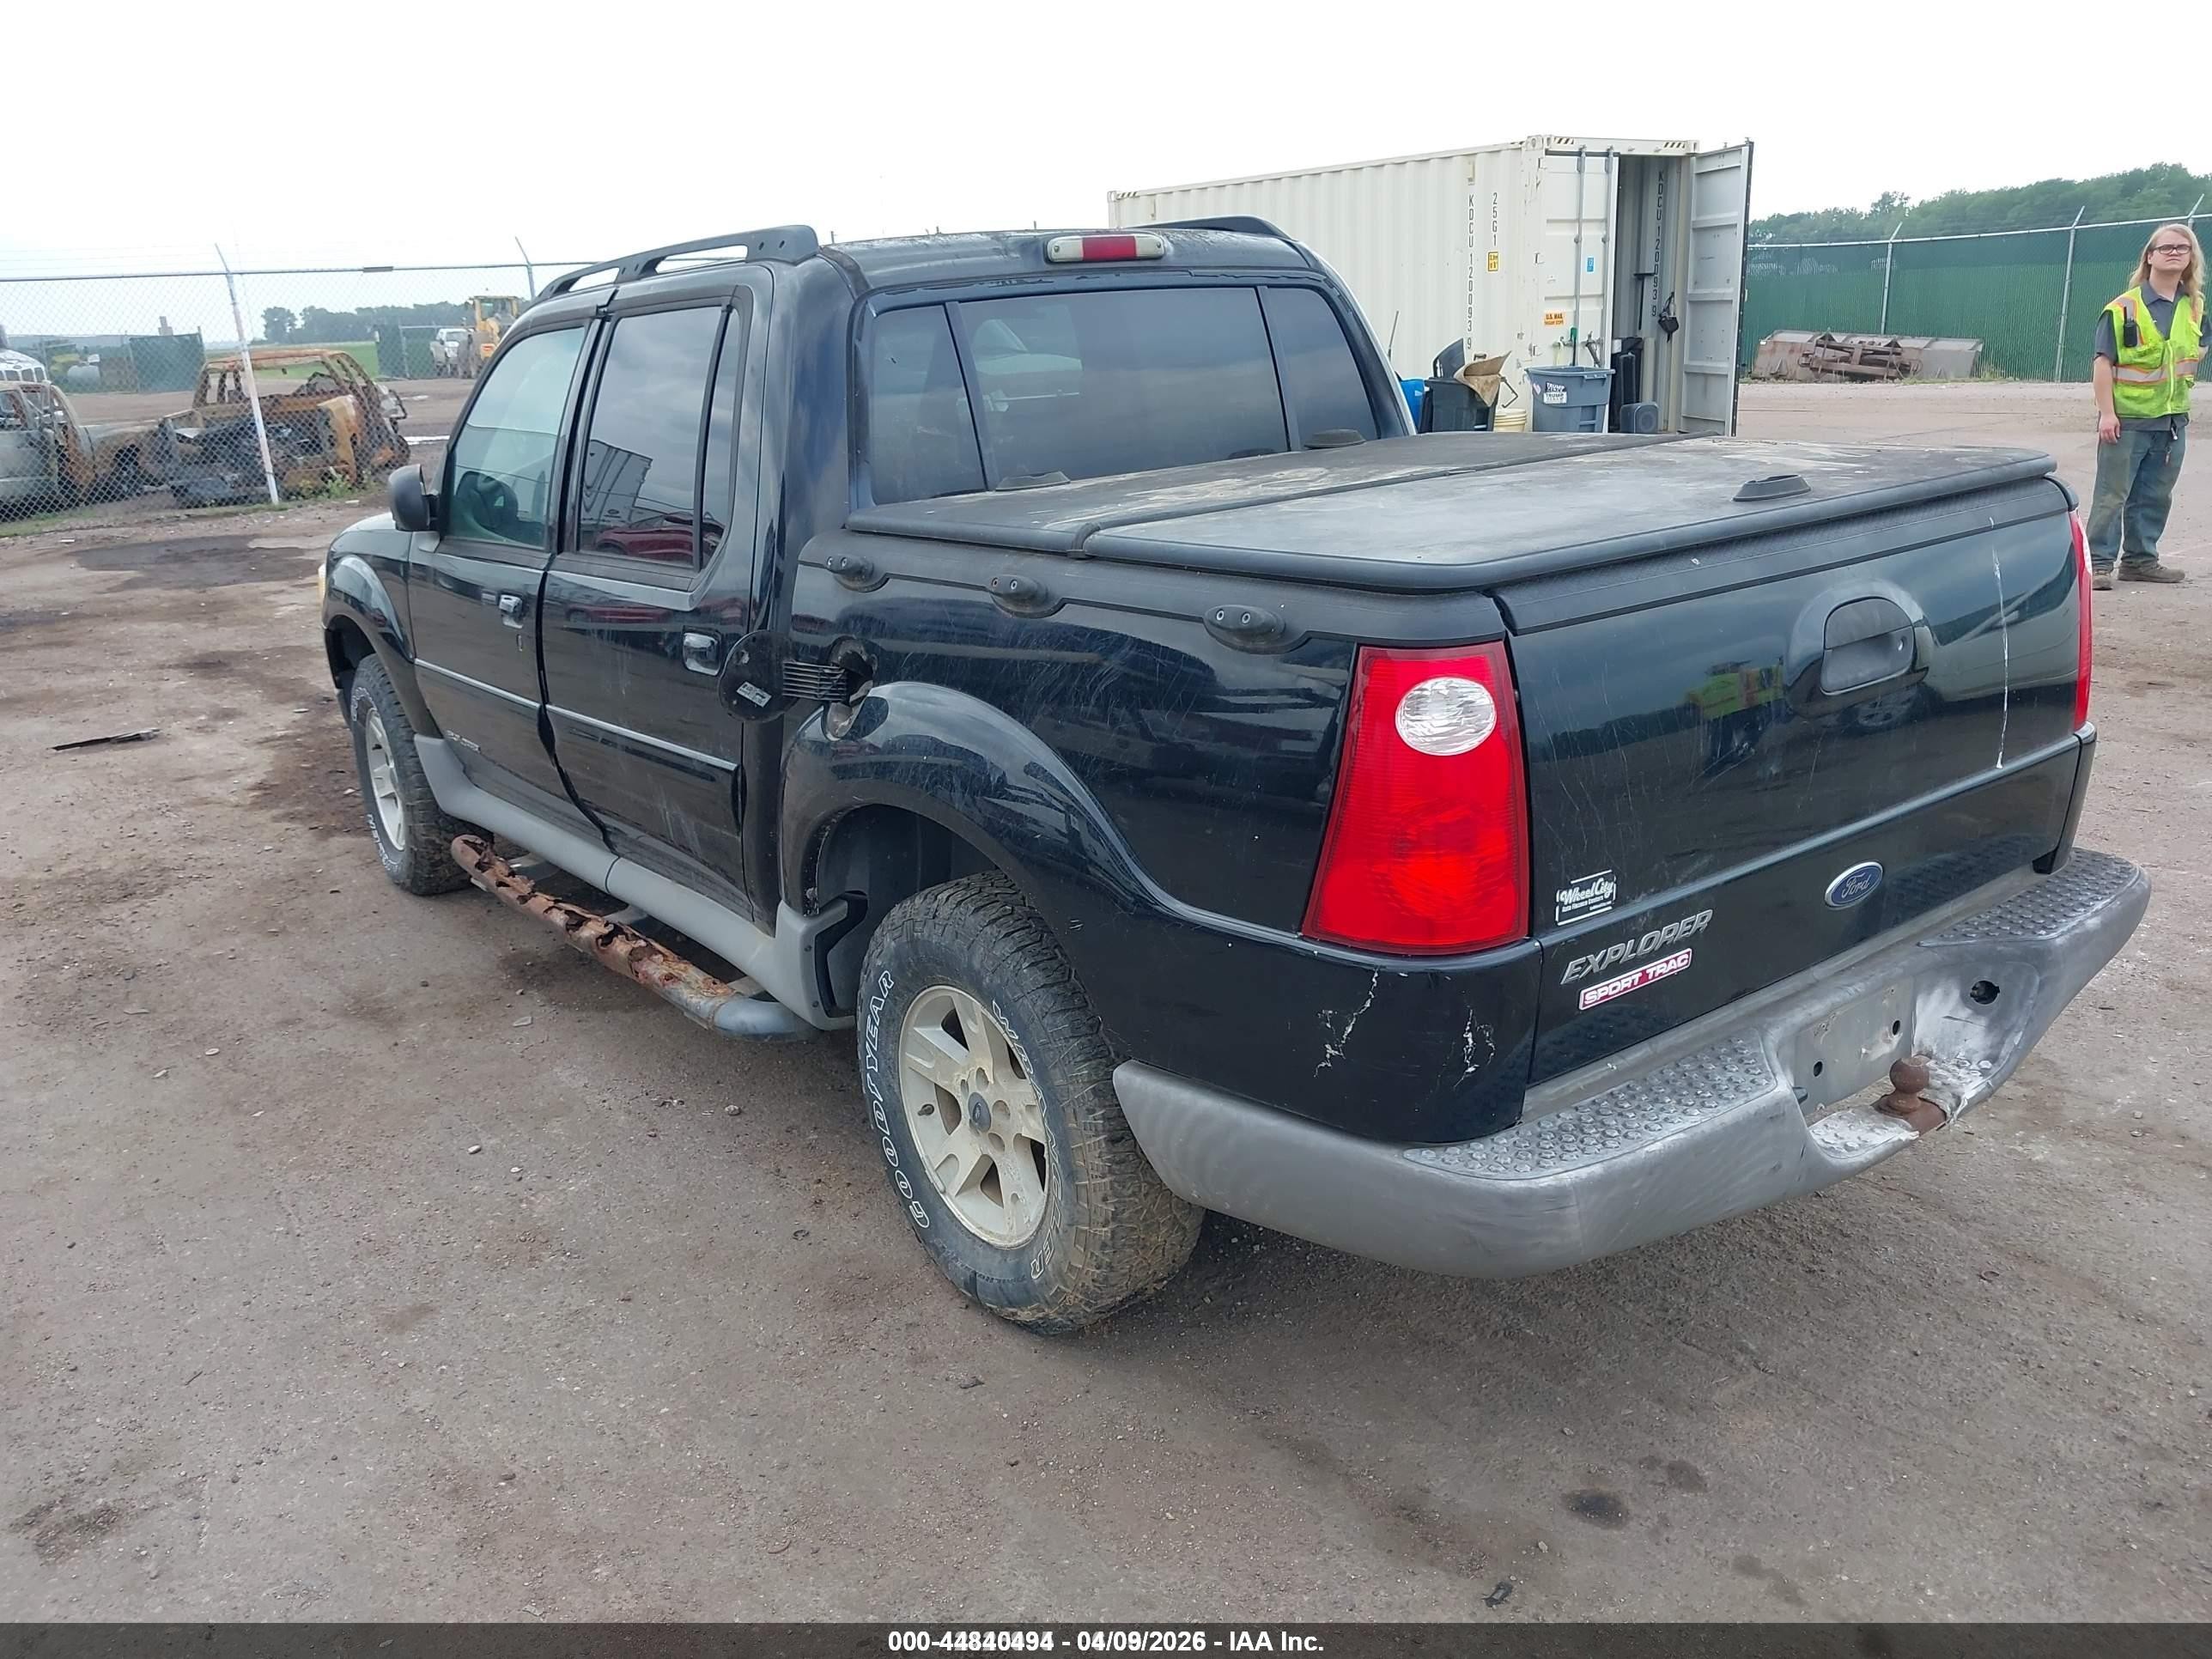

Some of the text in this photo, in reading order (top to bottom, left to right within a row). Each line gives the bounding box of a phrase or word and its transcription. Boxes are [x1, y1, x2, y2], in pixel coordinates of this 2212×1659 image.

[1652, 226, 1661, 301] 120093
[1841, 872, 1872, 899] Ford
[1560, 909, 1713, 985] EXPLORER
[1583, 953, 1690, 1006] SPORT TRAC
